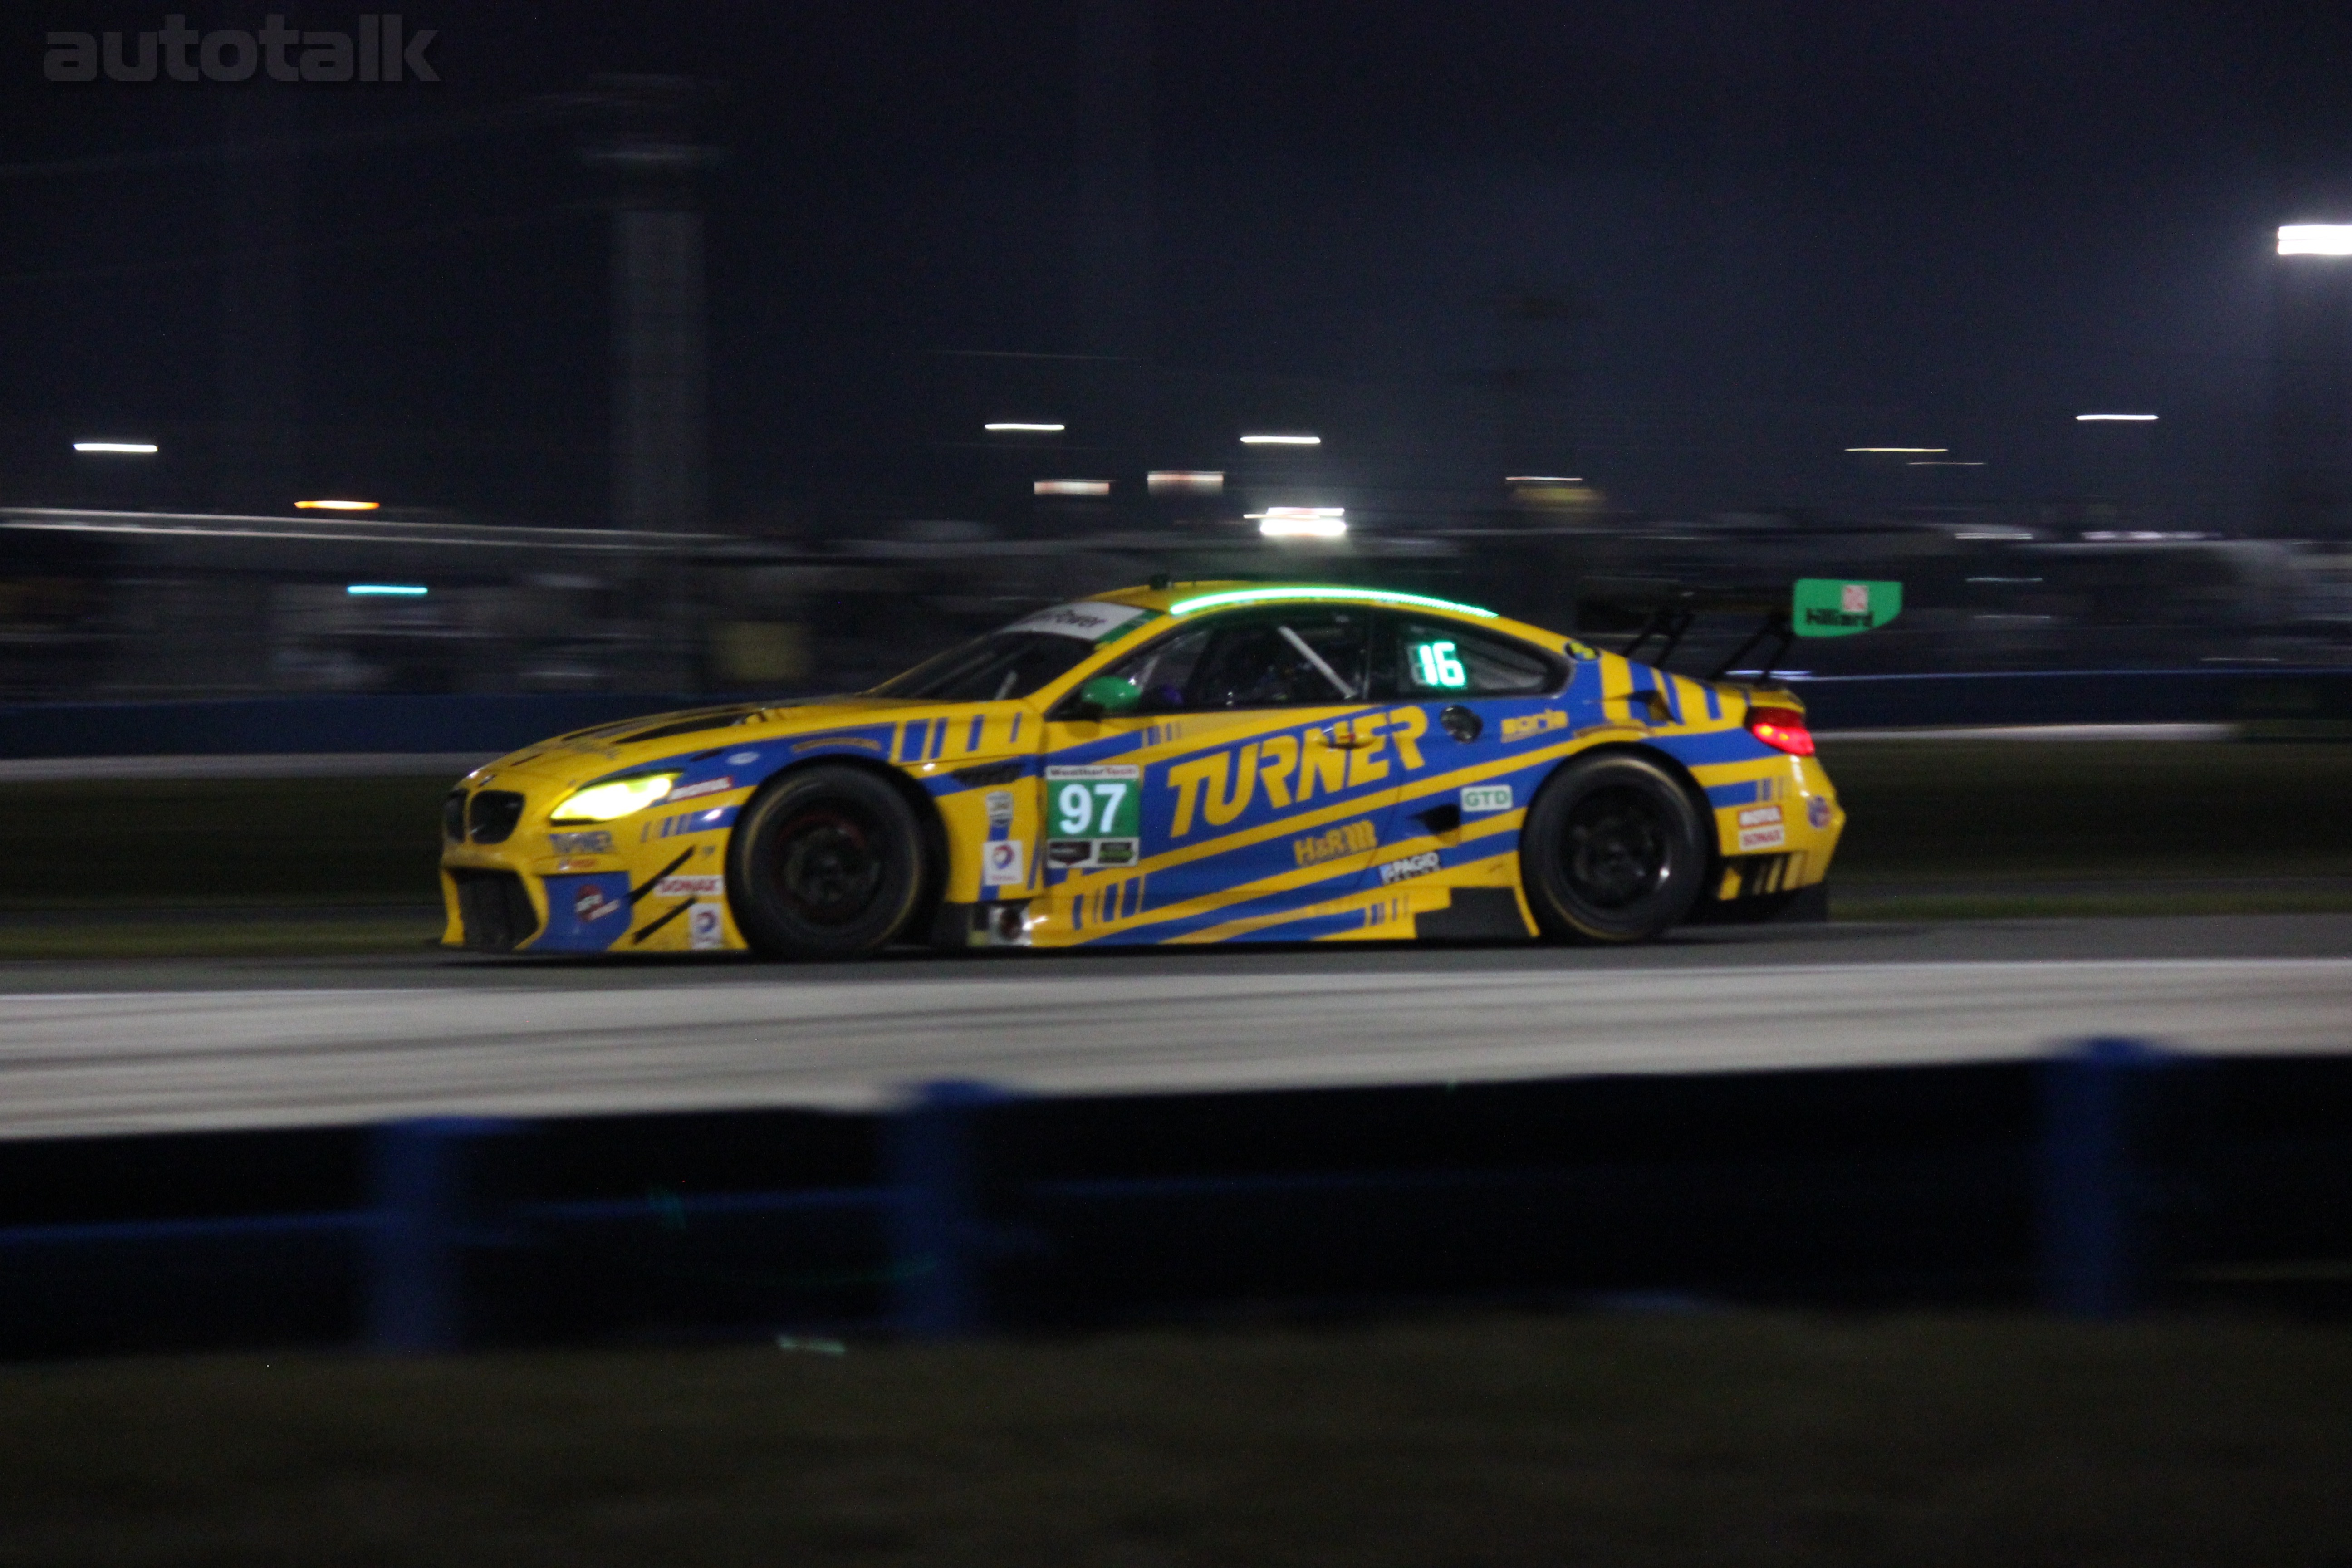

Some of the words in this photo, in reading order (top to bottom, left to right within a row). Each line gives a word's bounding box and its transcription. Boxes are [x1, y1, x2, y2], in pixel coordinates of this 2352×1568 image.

[1419, 642, 1467, 687] 16
[1168, 706, 1428, 838] TURNER
[1059, 783, 1127, 834] 97
[1464, 789, 1509, 807] GTD
